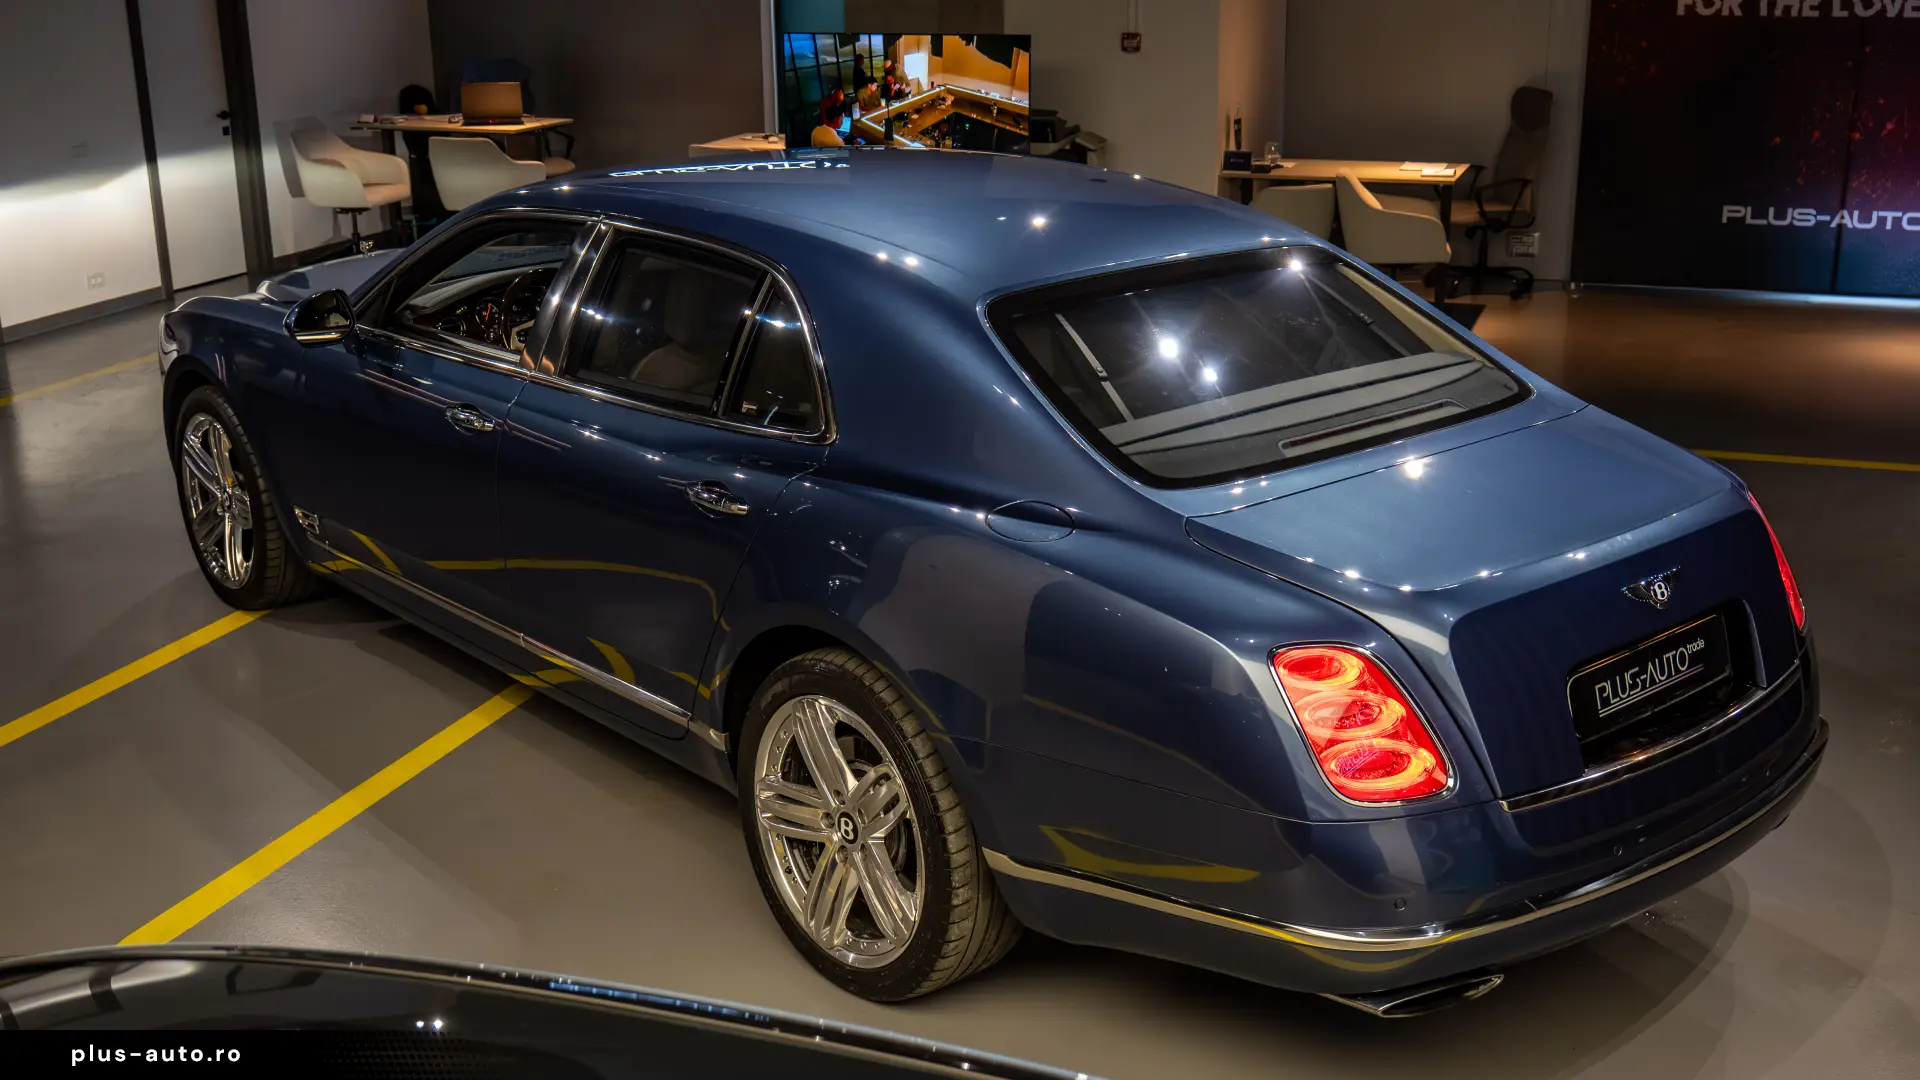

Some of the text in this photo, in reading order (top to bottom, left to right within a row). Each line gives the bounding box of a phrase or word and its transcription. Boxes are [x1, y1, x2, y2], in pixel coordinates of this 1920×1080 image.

[1759, 0, 1820, 18] THE
[1721, 205, 1920, 231] PLUS-AUTO
[1655, 582, 1667, 600] B
[1595, 637, 1705, 710] PLUS-AUTO trade
[840, 817, 854, 840] B
